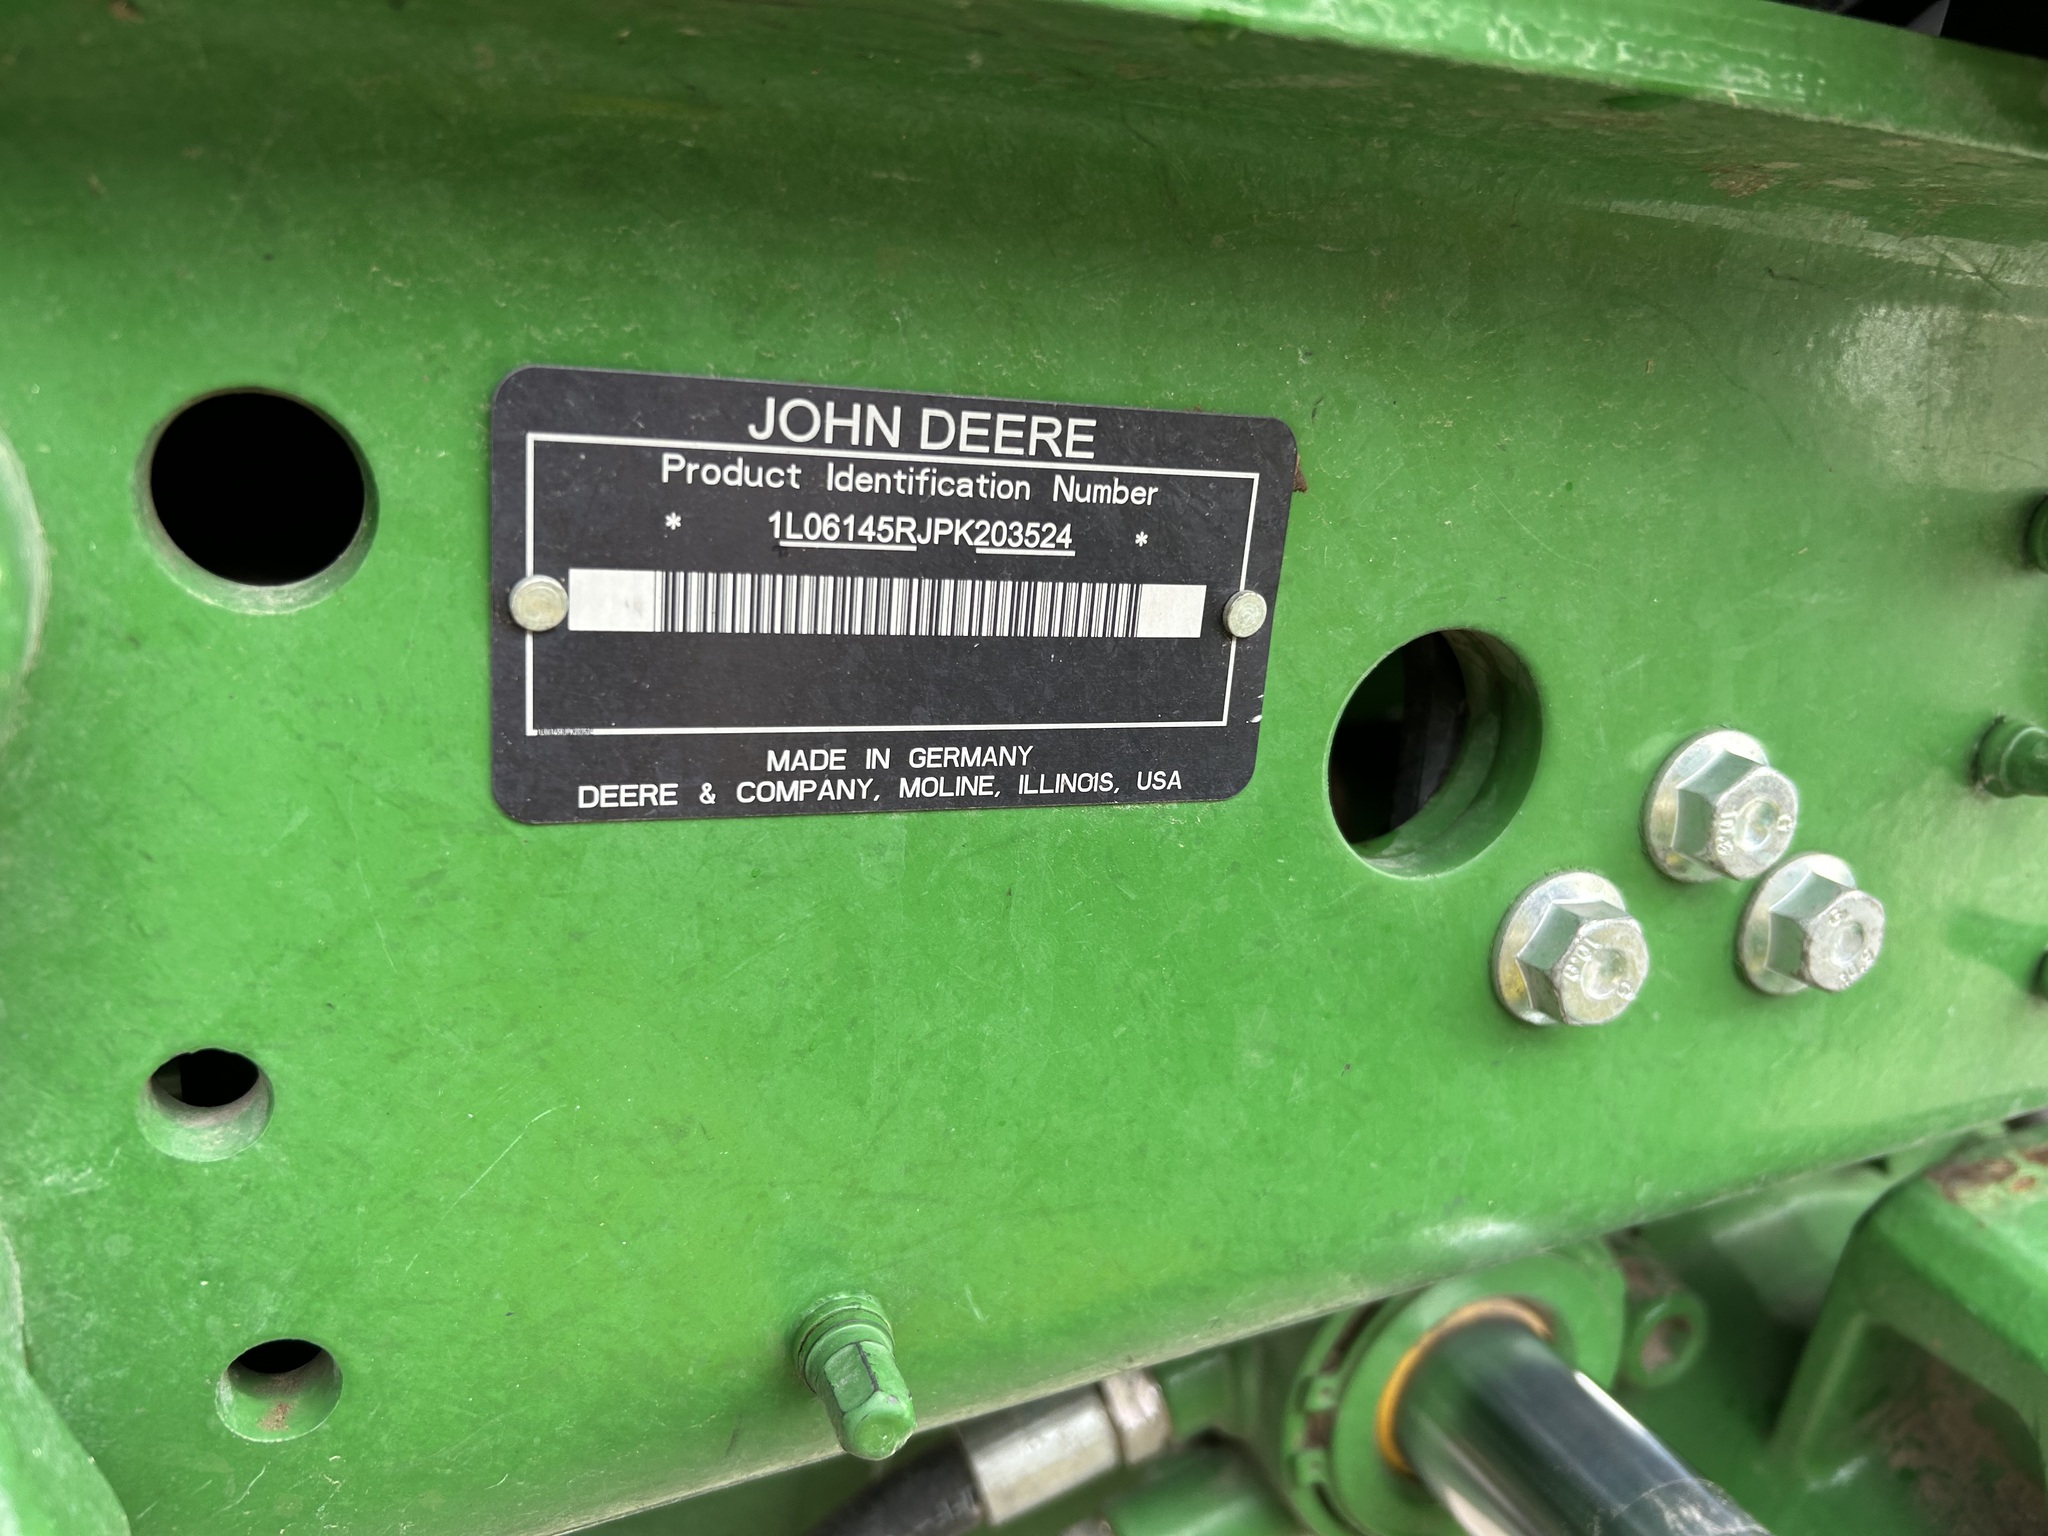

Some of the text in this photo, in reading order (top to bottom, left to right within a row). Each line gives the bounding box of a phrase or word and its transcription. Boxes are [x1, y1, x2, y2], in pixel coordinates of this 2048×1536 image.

[747, 396, 1097, 460] JOHN DEERE
[661, 451, 1159, 506] Product Identification Number
[768, 509, 1074, 551] 1L06145RJPK203524
[766, 745, 1034, 773] MADE IN GERMANY
[577, 769, 1182, 809] DEERE & COMPANY, MOLINE, ILLINOIS, USA
